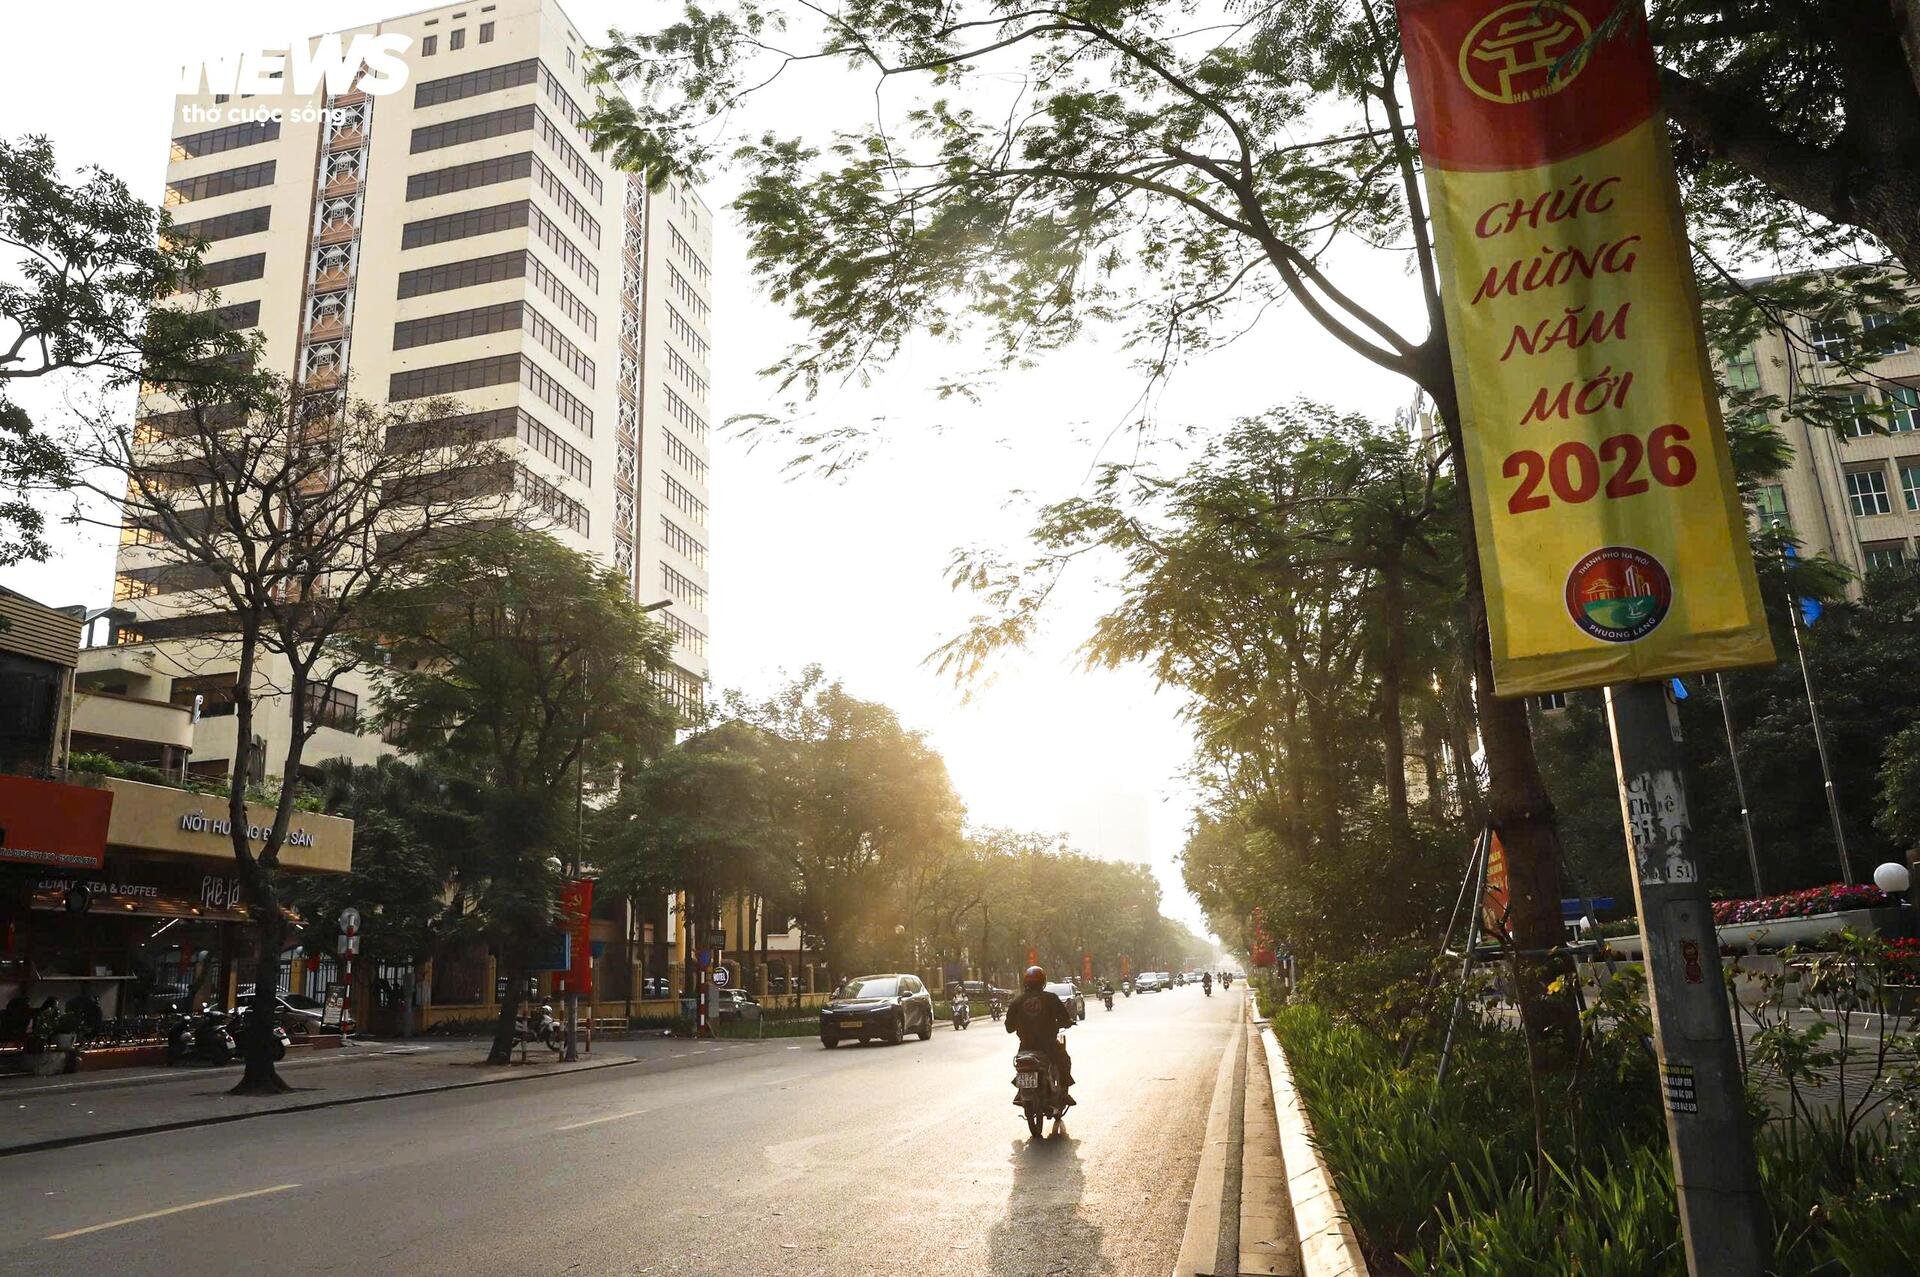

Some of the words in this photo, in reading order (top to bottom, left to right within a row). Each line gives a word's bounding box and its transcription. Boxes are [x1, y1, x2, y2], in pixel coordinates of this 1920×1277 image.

[1475, 175, 1621, 238] CHÚC
[1472, 234, 1640, 305] MỪNG
[1500, 303, 1632, 361] NĂM
[1520, 365, 1634, 425] MỚI
[1502, 424, 1697, 514] 2026
[88, 881, 107, 893] TEA
[109, 885, 116, 894] &
[120, 884, 158, 897] COFFEE
